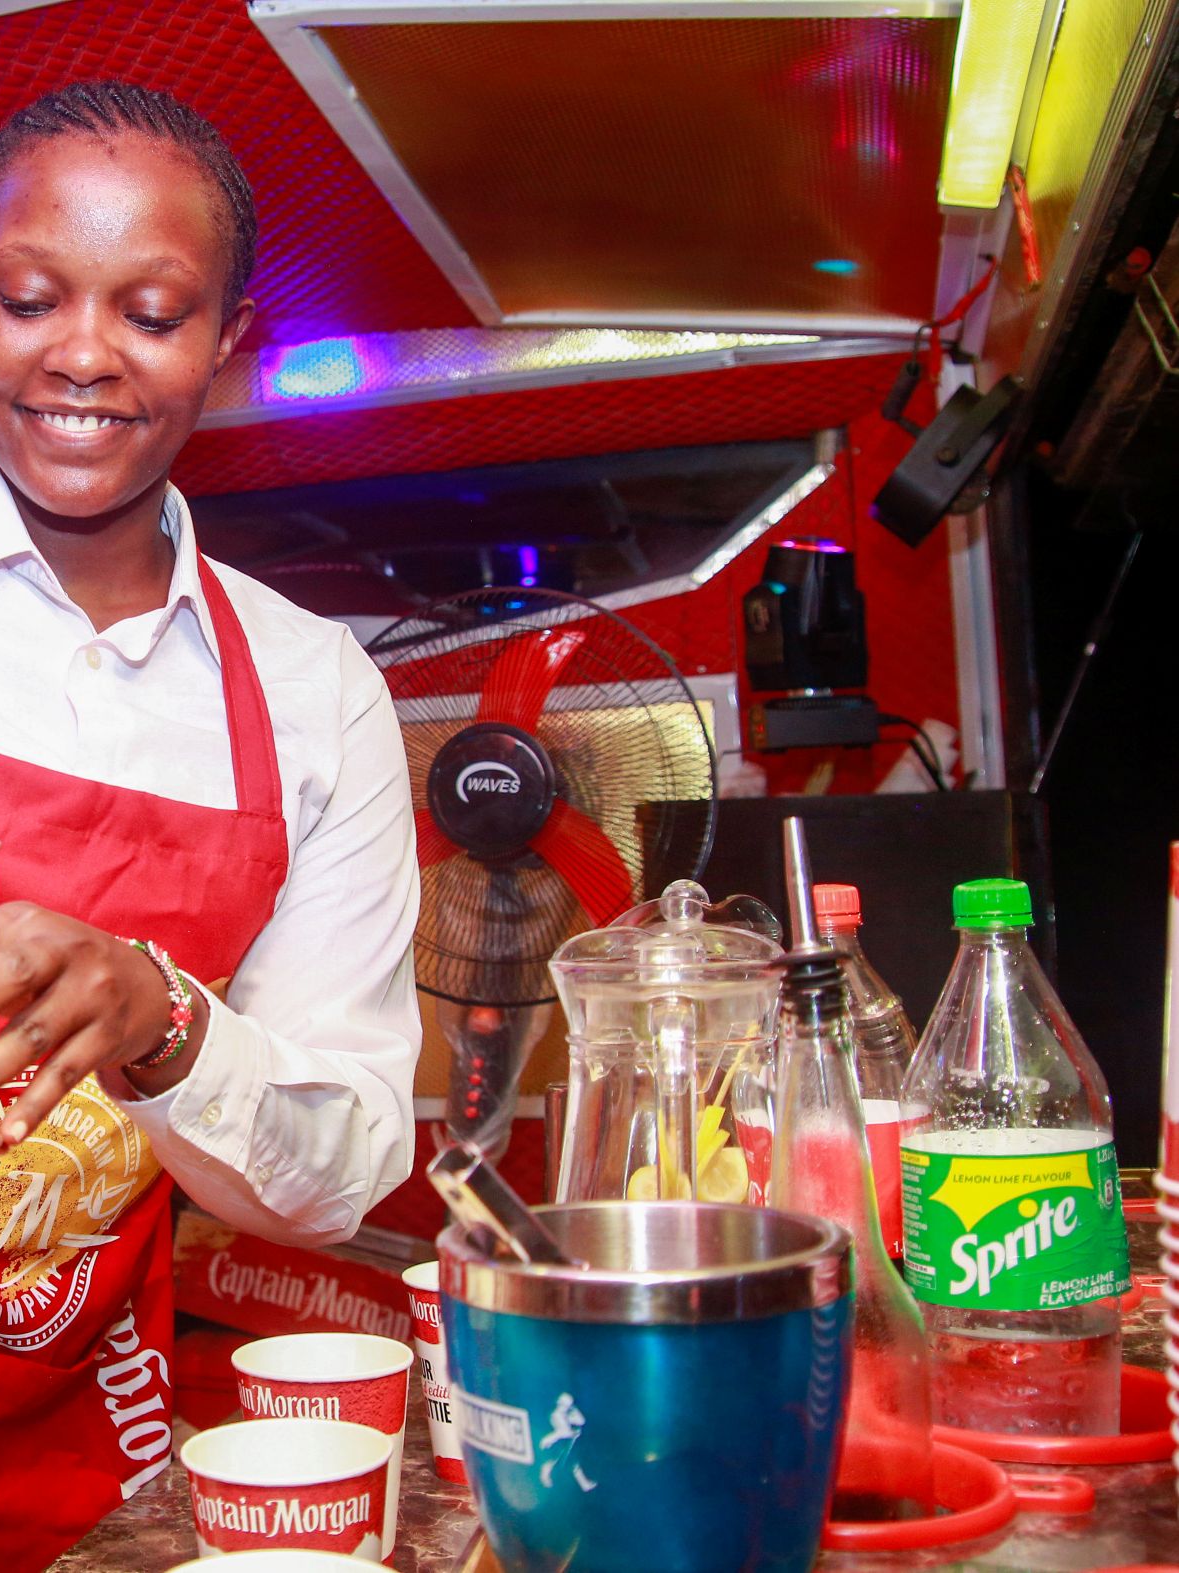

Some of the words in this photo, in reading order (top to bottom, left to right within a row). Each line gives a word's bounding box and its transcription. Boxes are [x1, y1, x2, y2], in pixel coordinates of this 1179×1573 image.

[467, 776, 520, 794] WAVES
[47, 1103, 117, 1170] MORGAN
[952, 1174, 992, 1185] LEMON
[993, 1175, 1020, 1185] LIME
[1022, 1171, 1072, 1184] FLAVOUR
[949, 1195, 1078, 1298] Sprite
[208, 1251, 305, 1312] Captain
[298, 1272, 412, 1341] Morgan
[1039, 1284, 1114, 1306] FLAVOURED
[1041, 1276, 1090, 1294] LEMON
[1090, 1270, 1115, 1285] LIME
[252, 1384, 340, 1421] Morgan
[192, 1483, 267, 1534] Captain
[265, 1493, 370, 1538] Morgan
